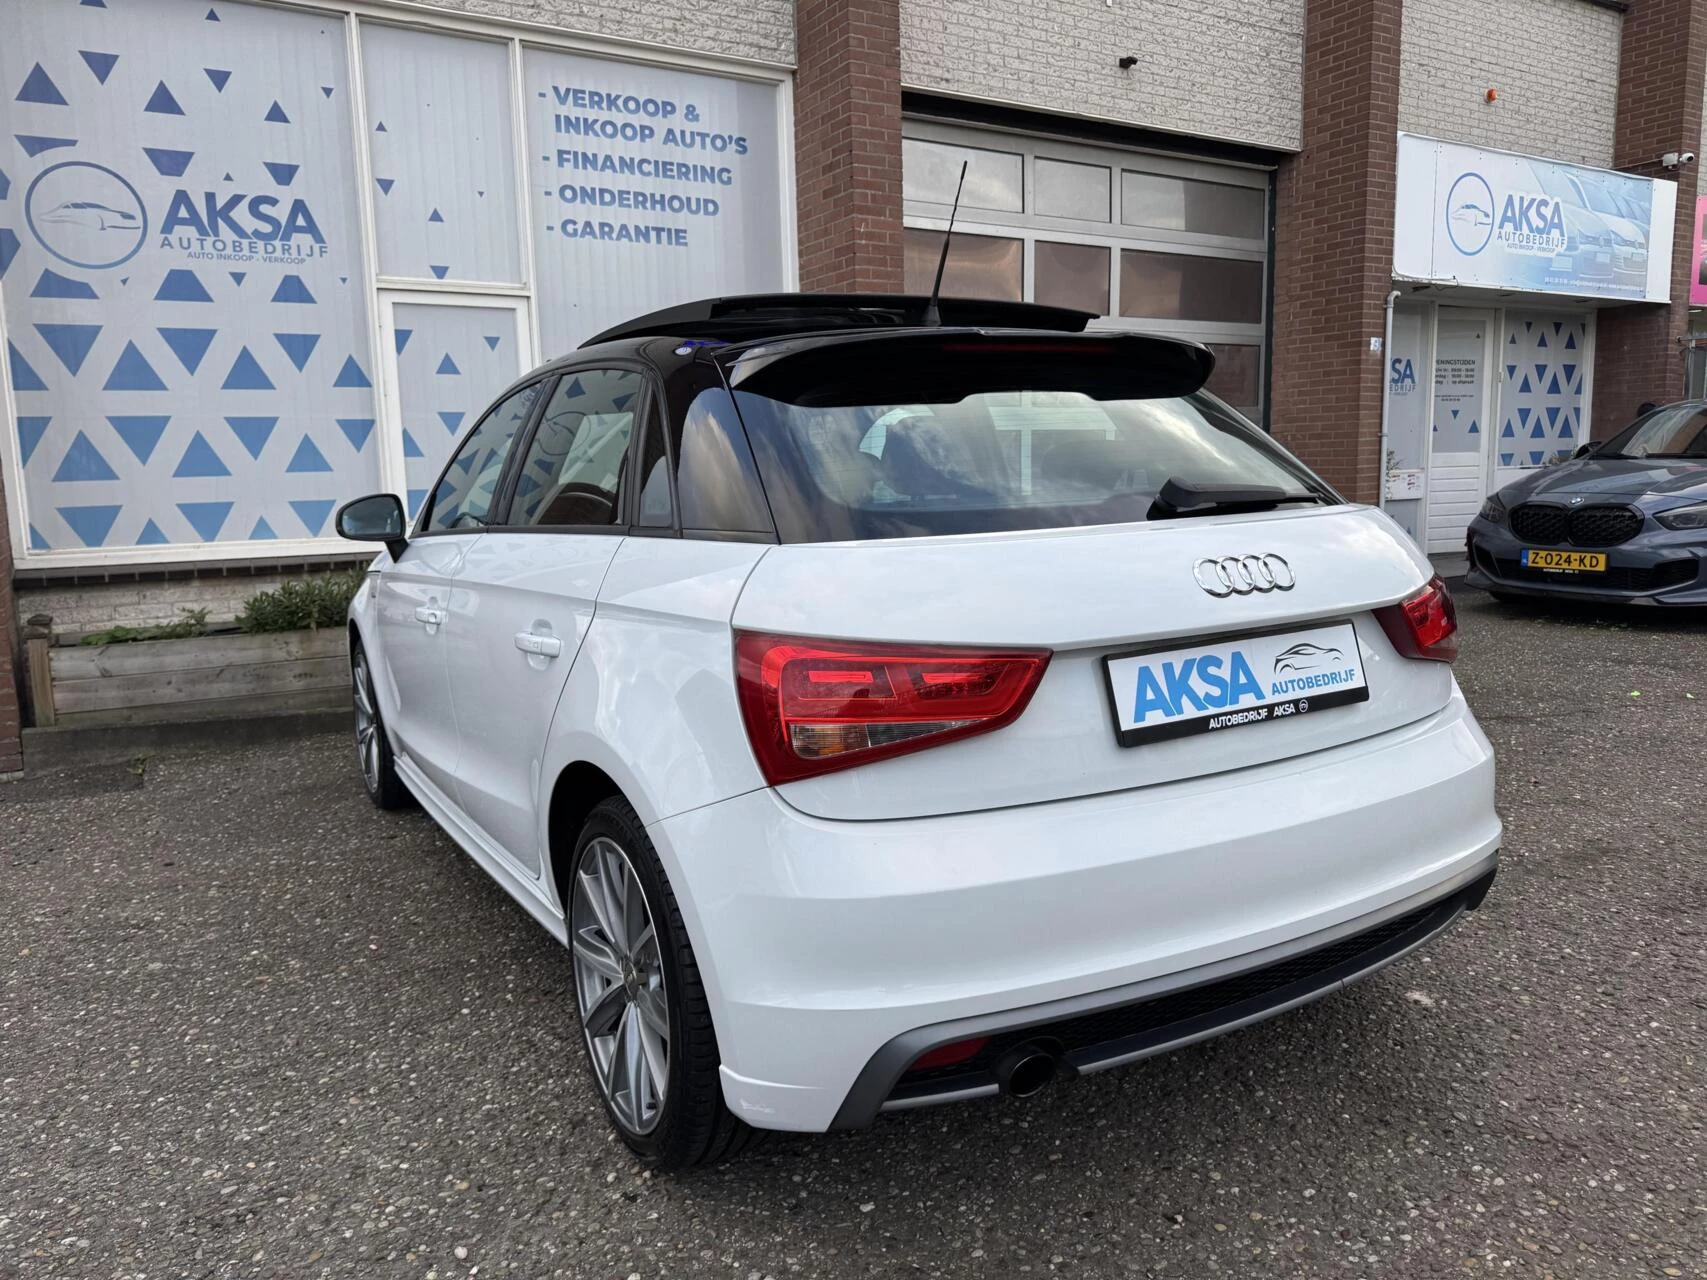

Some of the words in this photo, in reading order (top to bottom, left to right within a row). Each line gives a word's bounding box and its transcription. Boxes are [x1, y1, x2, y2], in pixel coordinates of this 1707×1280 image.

[552, 85, 676, 119] VERKOOP
[684, 104, 700, 122] &
[555, 114, 655, 143] INKOOP
[662, 128, 748, 155] AUTO'S
[557, 149, 732, 186] FINANCIERING
[559, 184, 719, 217] ONDERHOUD
[160, 189, 327, 244] AKSA
[1499, 194, 1565, 238] AKSA
[160, 236, 328, 258] AUTOBEDRIJF
[561, 218, 688, 247] GARANTIE
[1497, 231, 1565, 249] AUTOBEDRIJF
[187, 251, 214, 260] AUTO
[216, 253, 254, 262] INKOOP
[262, 255, 306, 265] VERKOOP
[1391, 358, 1416, 384] SA
[1531, 551, 1599, 568] Z-024-KD
[1133, 651, 1266, 723] AKSA
[1271, 668, 1356, 696] AUTOBEDRIJF
[1208, 708, 1268, 730] AUTOBEDRIJF
[1273, 703, 1296, 718] AKSA
